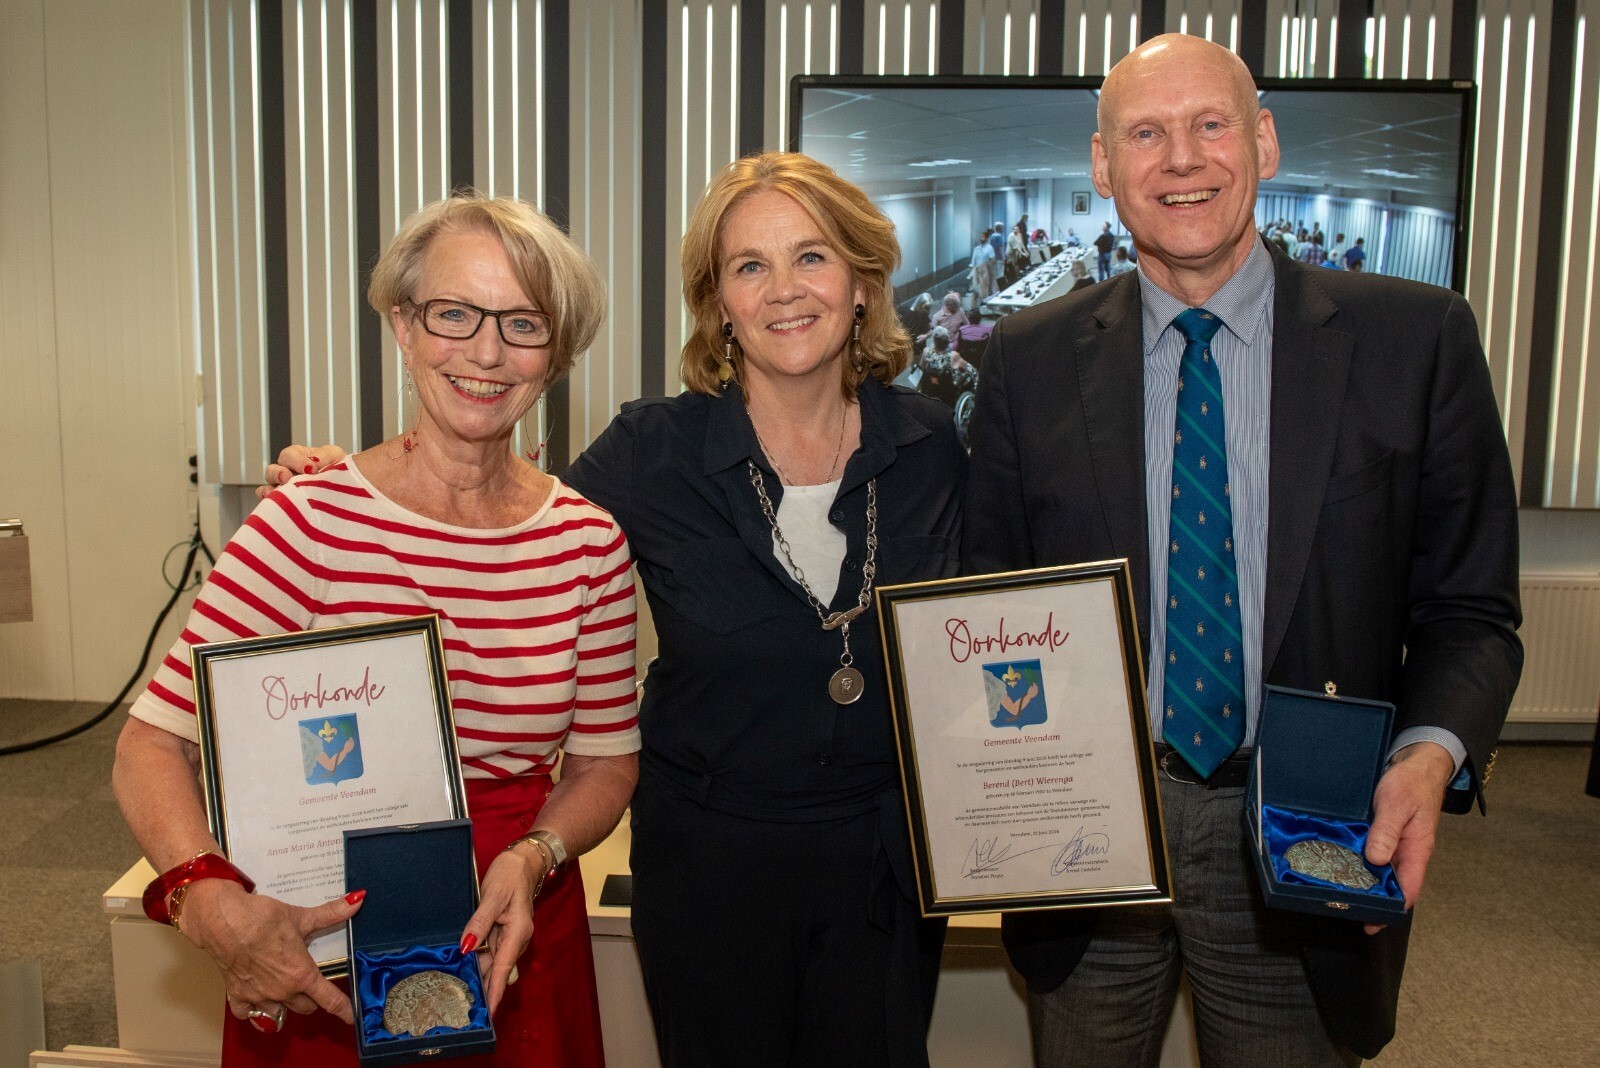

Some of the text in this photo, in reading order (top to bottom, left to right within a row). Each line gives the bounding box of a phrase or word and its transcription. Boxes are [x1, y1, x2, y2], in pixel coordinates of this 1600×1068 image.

[945, 611, 1069, 663] Oorkonde
[262, 666, 386, 721] Oorkonde
[983, 733, 1061, 747] Gemeente Veendam
[983, 775, 1074, 790] Berend (Bert) Wierenga
[299, 787, 377, 806] Gemeente Veendam
[266, 846, 289, 857] Anna
[290, 842, 315, 853] Maria
